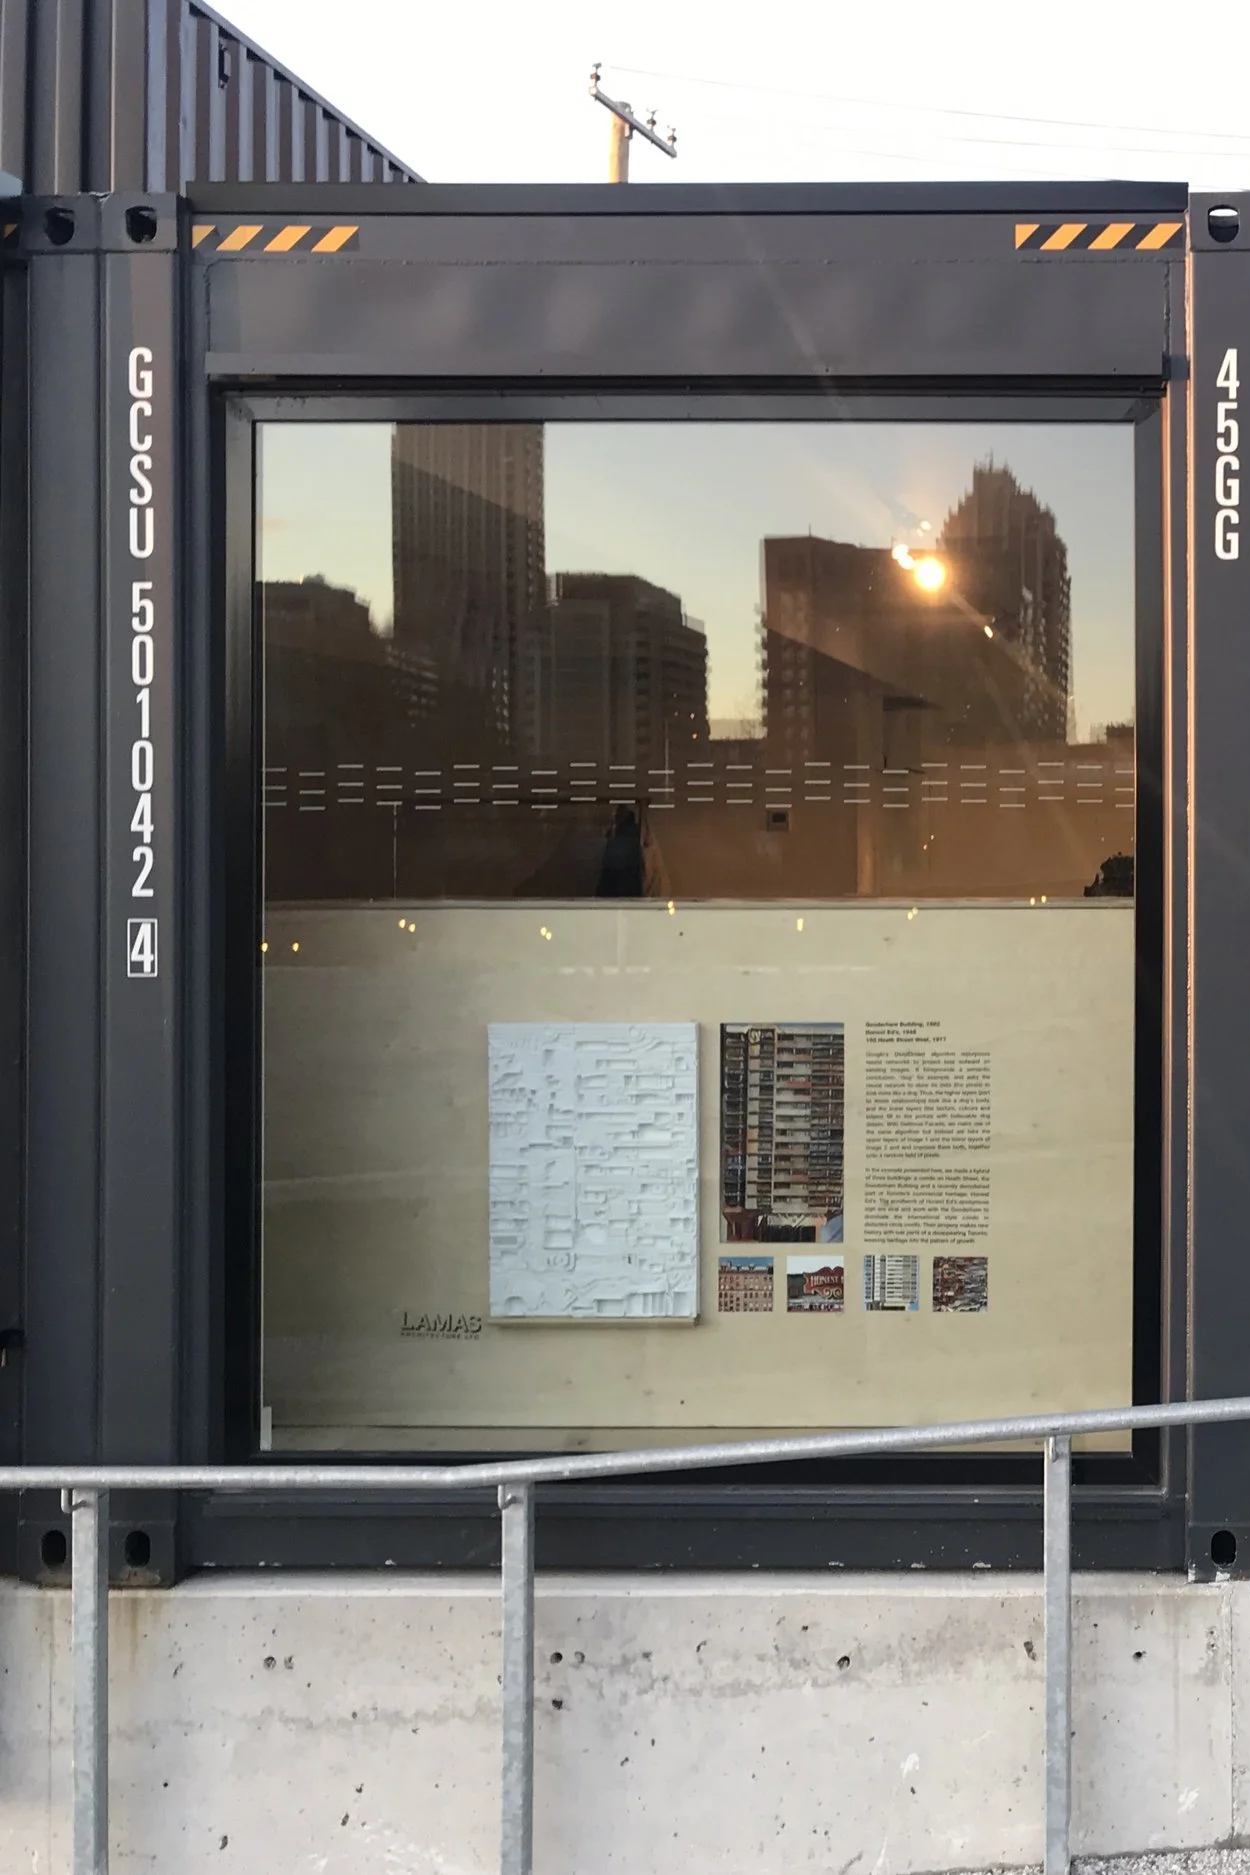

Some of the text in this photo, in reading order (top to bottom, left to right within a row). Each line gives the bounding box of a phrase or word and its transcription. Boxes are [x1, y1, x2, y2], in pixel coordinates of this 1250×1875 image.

[1214, 348, 1240, 561] 45GG
[128, 347, 154, 973] GCSU 501042 4
[401, 1311, 482, 1333] LAMAS
